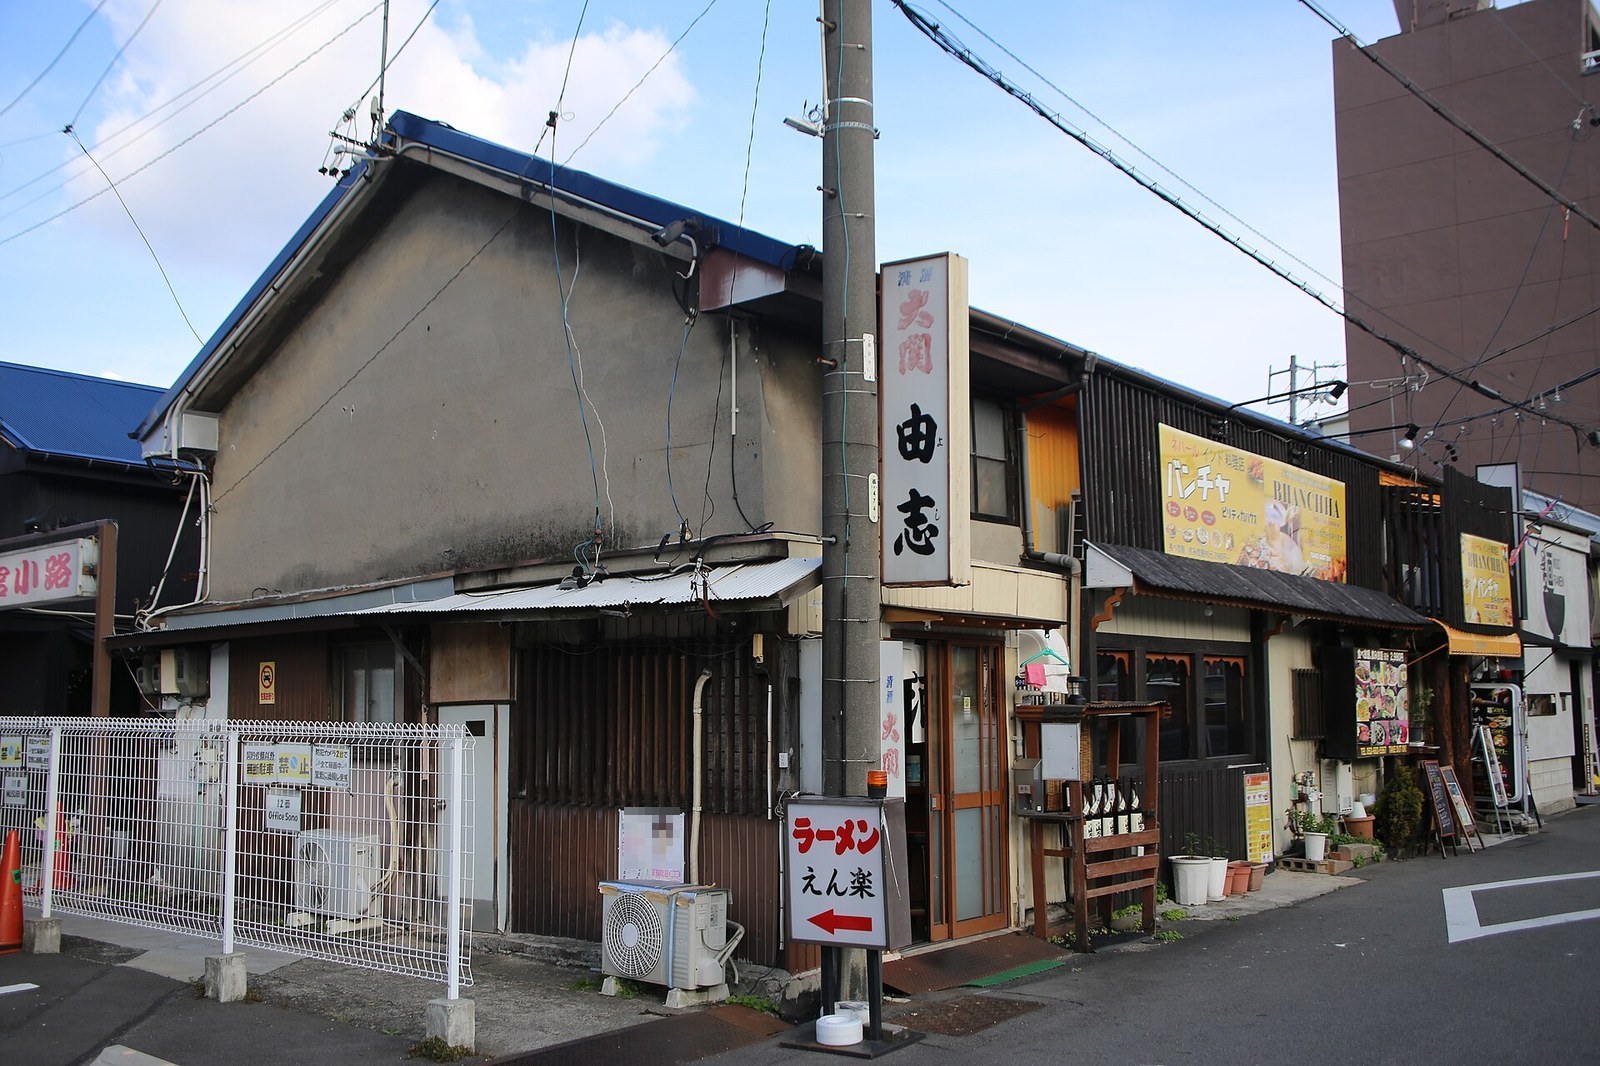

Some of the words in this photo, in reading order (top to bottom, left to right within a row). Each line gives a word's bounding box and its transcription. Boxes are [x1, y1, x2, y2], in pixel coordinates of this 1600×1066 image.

[897, 288, 934, 375] 大関
[893, 403, 940, 556] 由志
[1167, 458, 1230, 503] バンチャ
[1273, 479, 1340, 519] BHANCHHA
[882, 712, 899, 779] 大関
[268, 811, 284, 821] Office
[792, 817, 880, 856] ラーメン
[801, 866, 875, 899] えん楽
